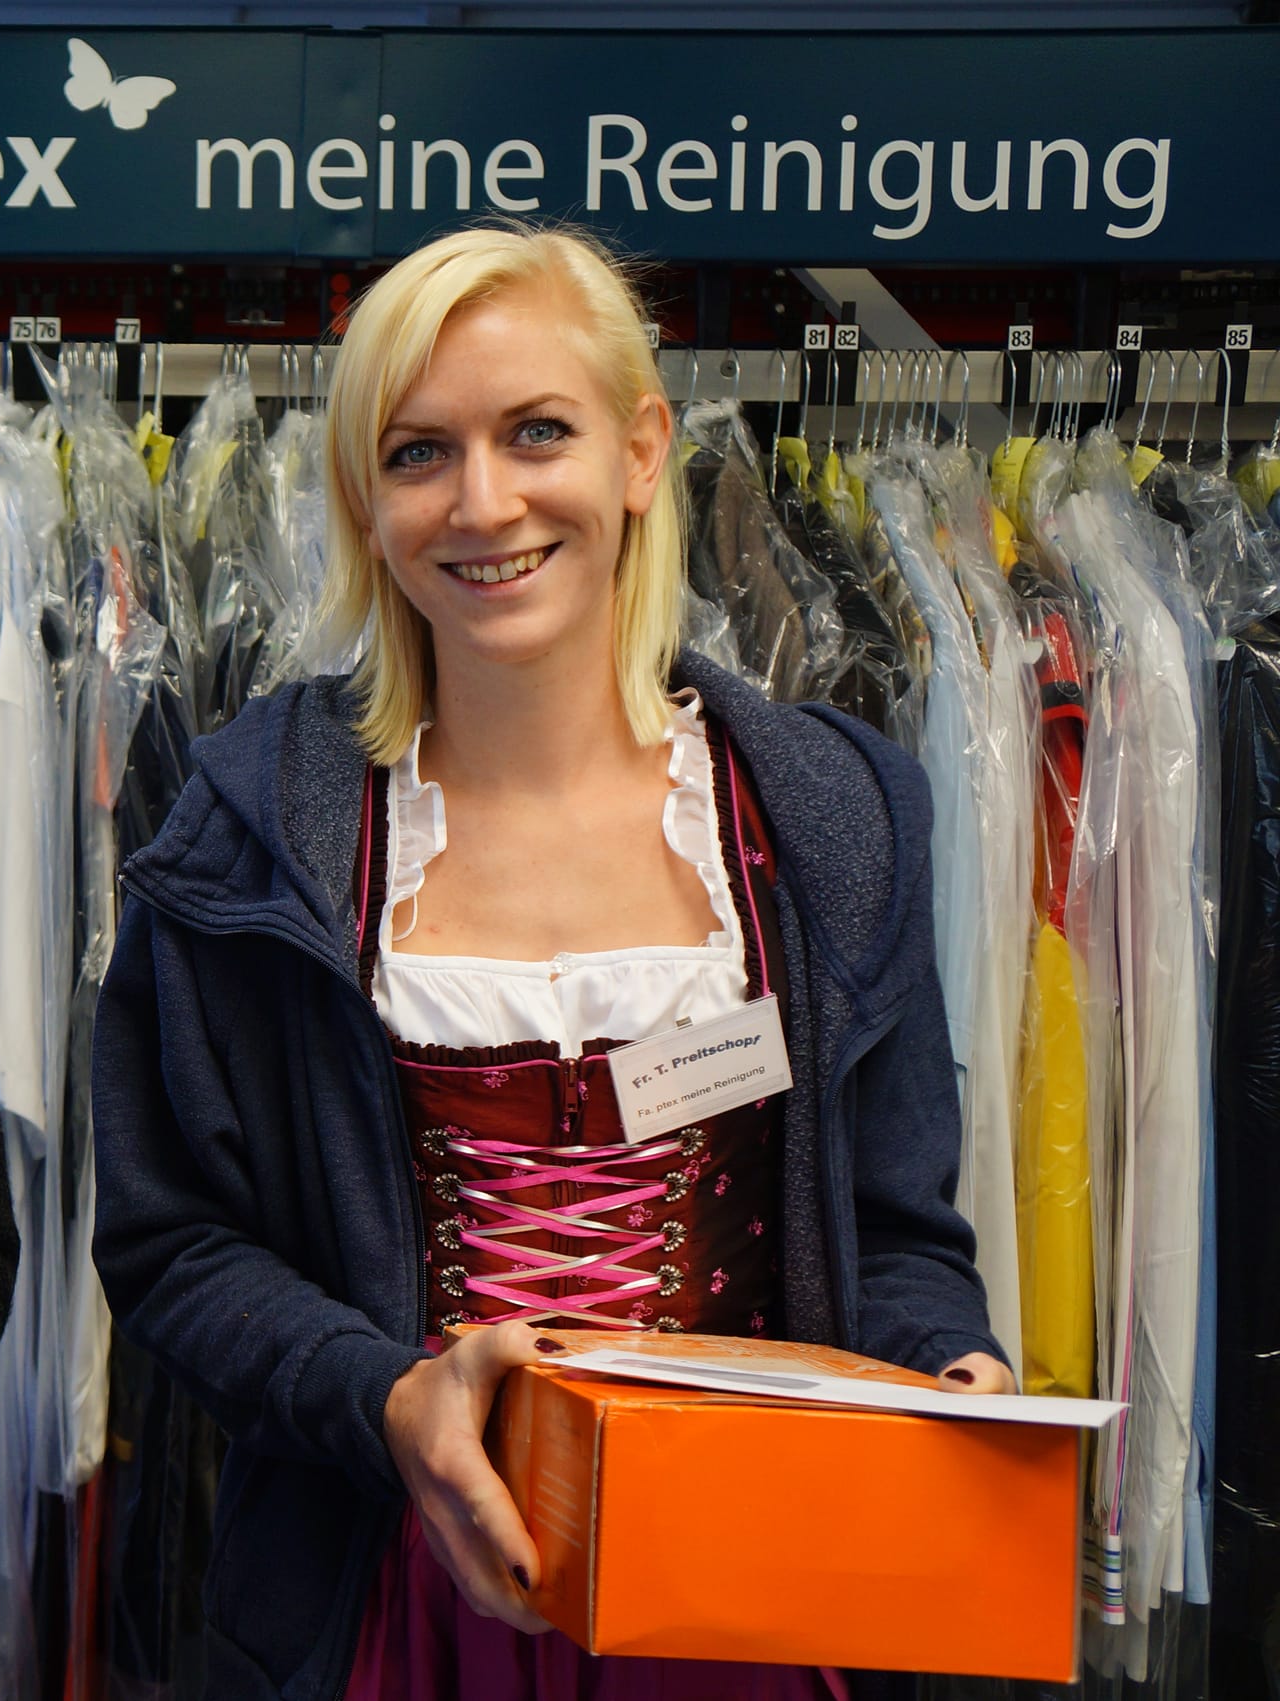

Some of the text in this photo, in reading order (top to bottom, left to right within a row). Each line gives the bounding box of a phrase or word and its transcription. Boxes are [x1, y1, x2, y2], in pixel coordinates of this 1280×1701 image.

[197, 114, 544, 212] meine
[588, 114, 1171, 240] Reinigung
[13, 321, 32, 338] 75
[36, 321, 56, 339] 76
[117, 322, 138, 340] 77
[808, 329, 826, 346] 81
[837, 329, 857, 346] 82
[1011, 329, 1031, 347] 83
[1119, 330, 1140, 347] 84
[1227, 329, 1248, 346] 85
[632, 1034, 761, 1089] Fr. T. Preitschopf
[637, 1065, 766, 1118] Fa. ptex meine Reinigung
